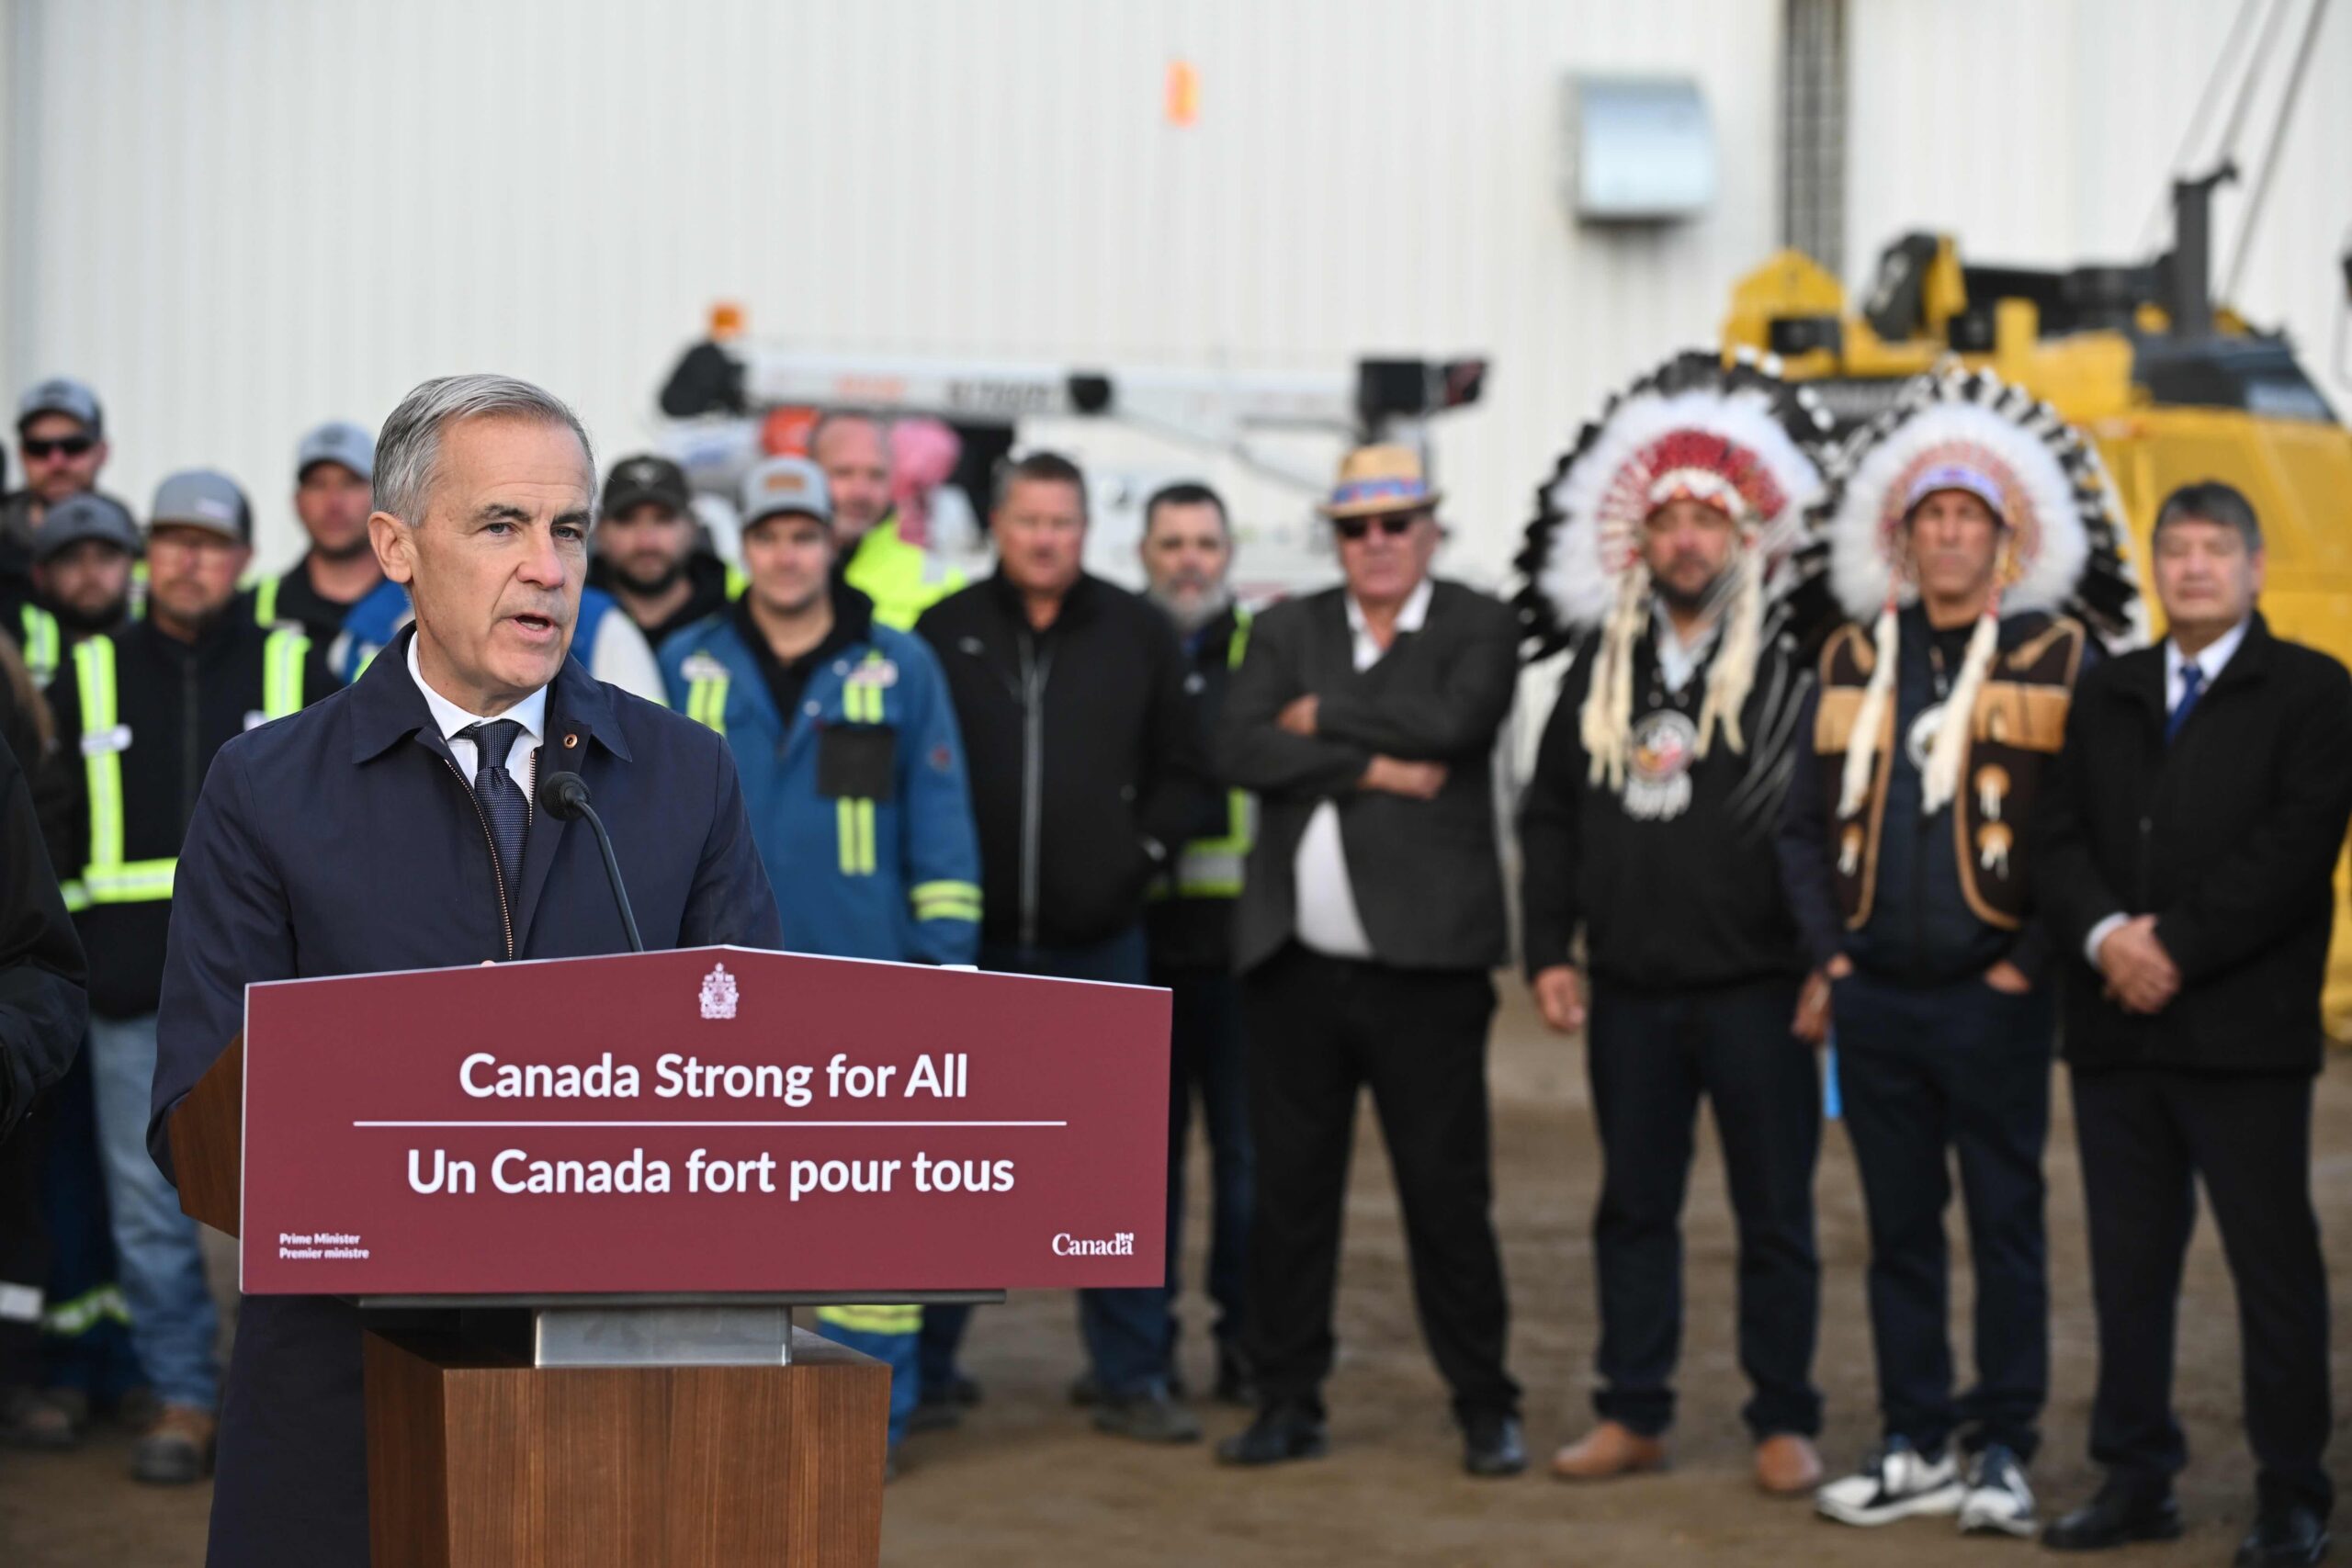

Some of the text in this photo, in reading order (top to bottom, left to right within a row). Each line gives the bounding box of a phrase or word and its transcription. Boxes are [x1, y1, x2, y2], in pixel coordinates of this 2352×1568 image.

[460, 1053, 967, 1108] Canada Strong for All
[409, 1148, 1015, 1201] Un Canada fort pour tous
[279, 1233, 360, 1245] Prime Minister
[1052, 1233, 1134, 1256] Canada
[279, 1247, 369, 1259] Premier ministre
